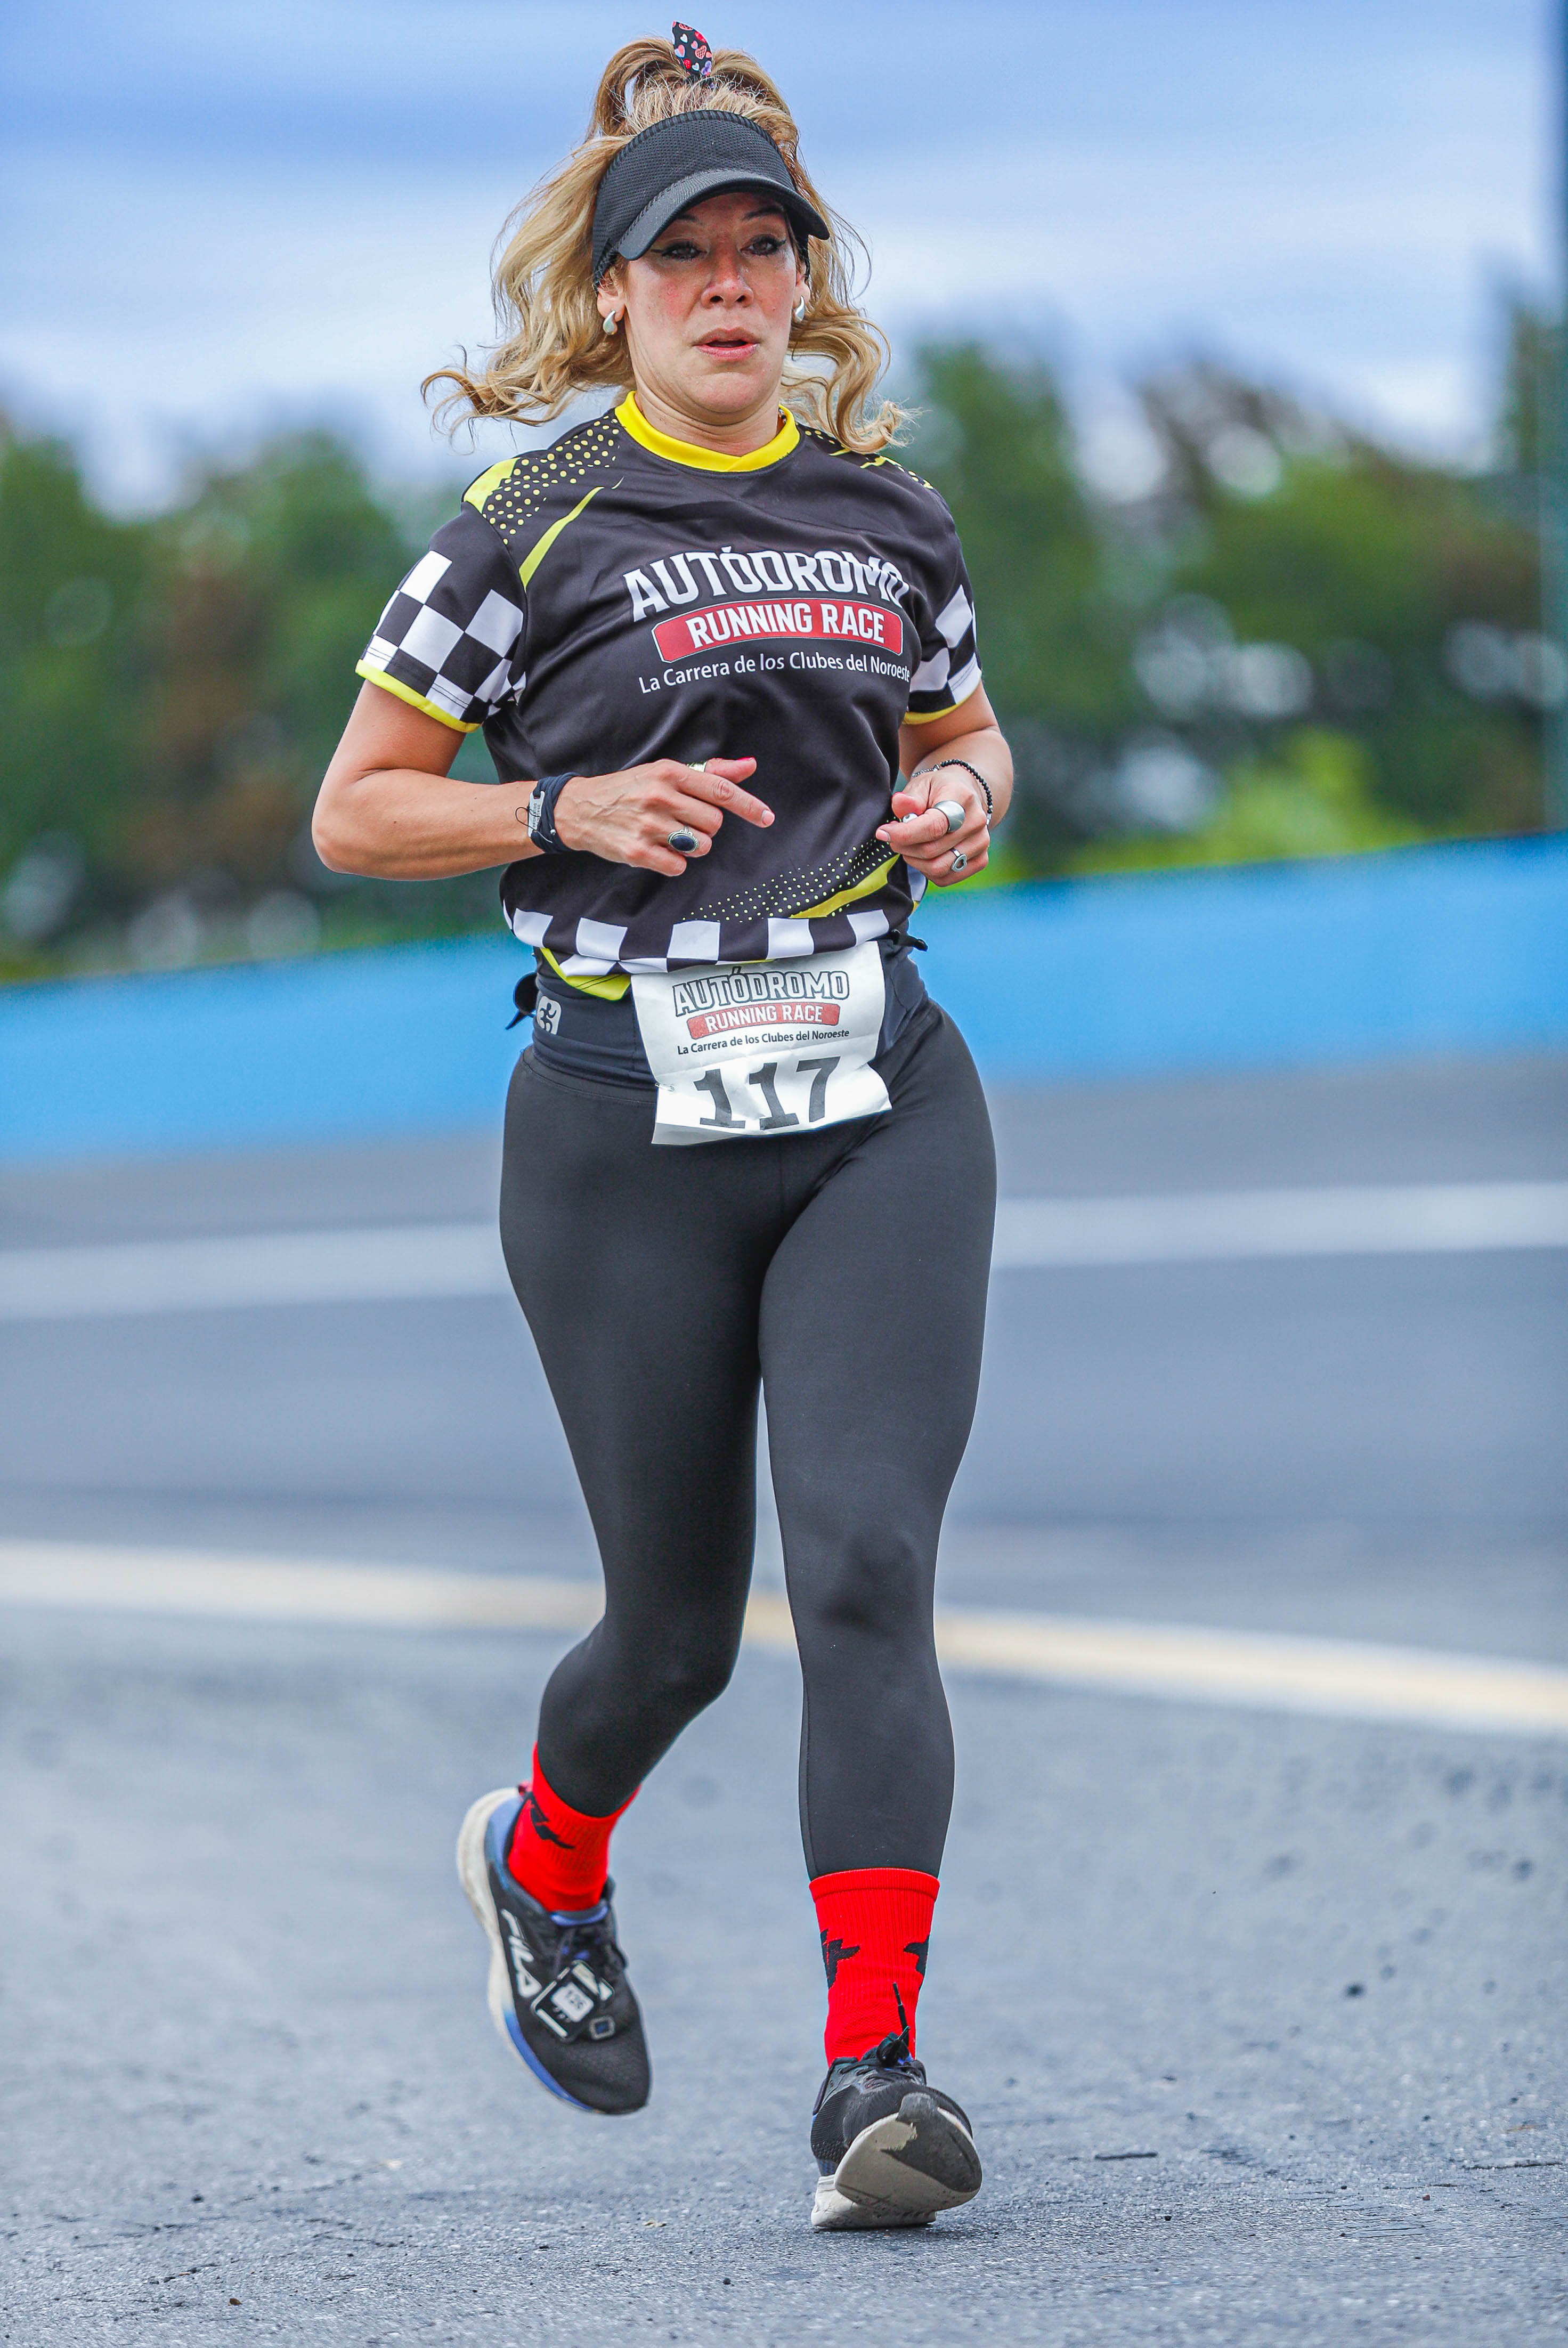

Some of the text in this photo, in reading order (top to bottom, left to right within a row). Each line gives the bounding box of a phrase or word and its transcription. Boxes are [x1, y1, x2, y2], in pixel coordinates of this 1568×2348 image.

[622, 546, 909, 622] AUTÓDROMO
[685, 603, 885, 648] RUNNING RACE
[639, 651, 910, 694] La Carrera de los Clubes del Noroeste
[672, 966, 850, 1017] AUTÓDROMO
[705, 1004, 823, 1033] RUNNING RACE
[678, 1029, 849, 1055] La Carrera de los Clubes del Noroeste
[694, 1056, 840, 1130] 117
